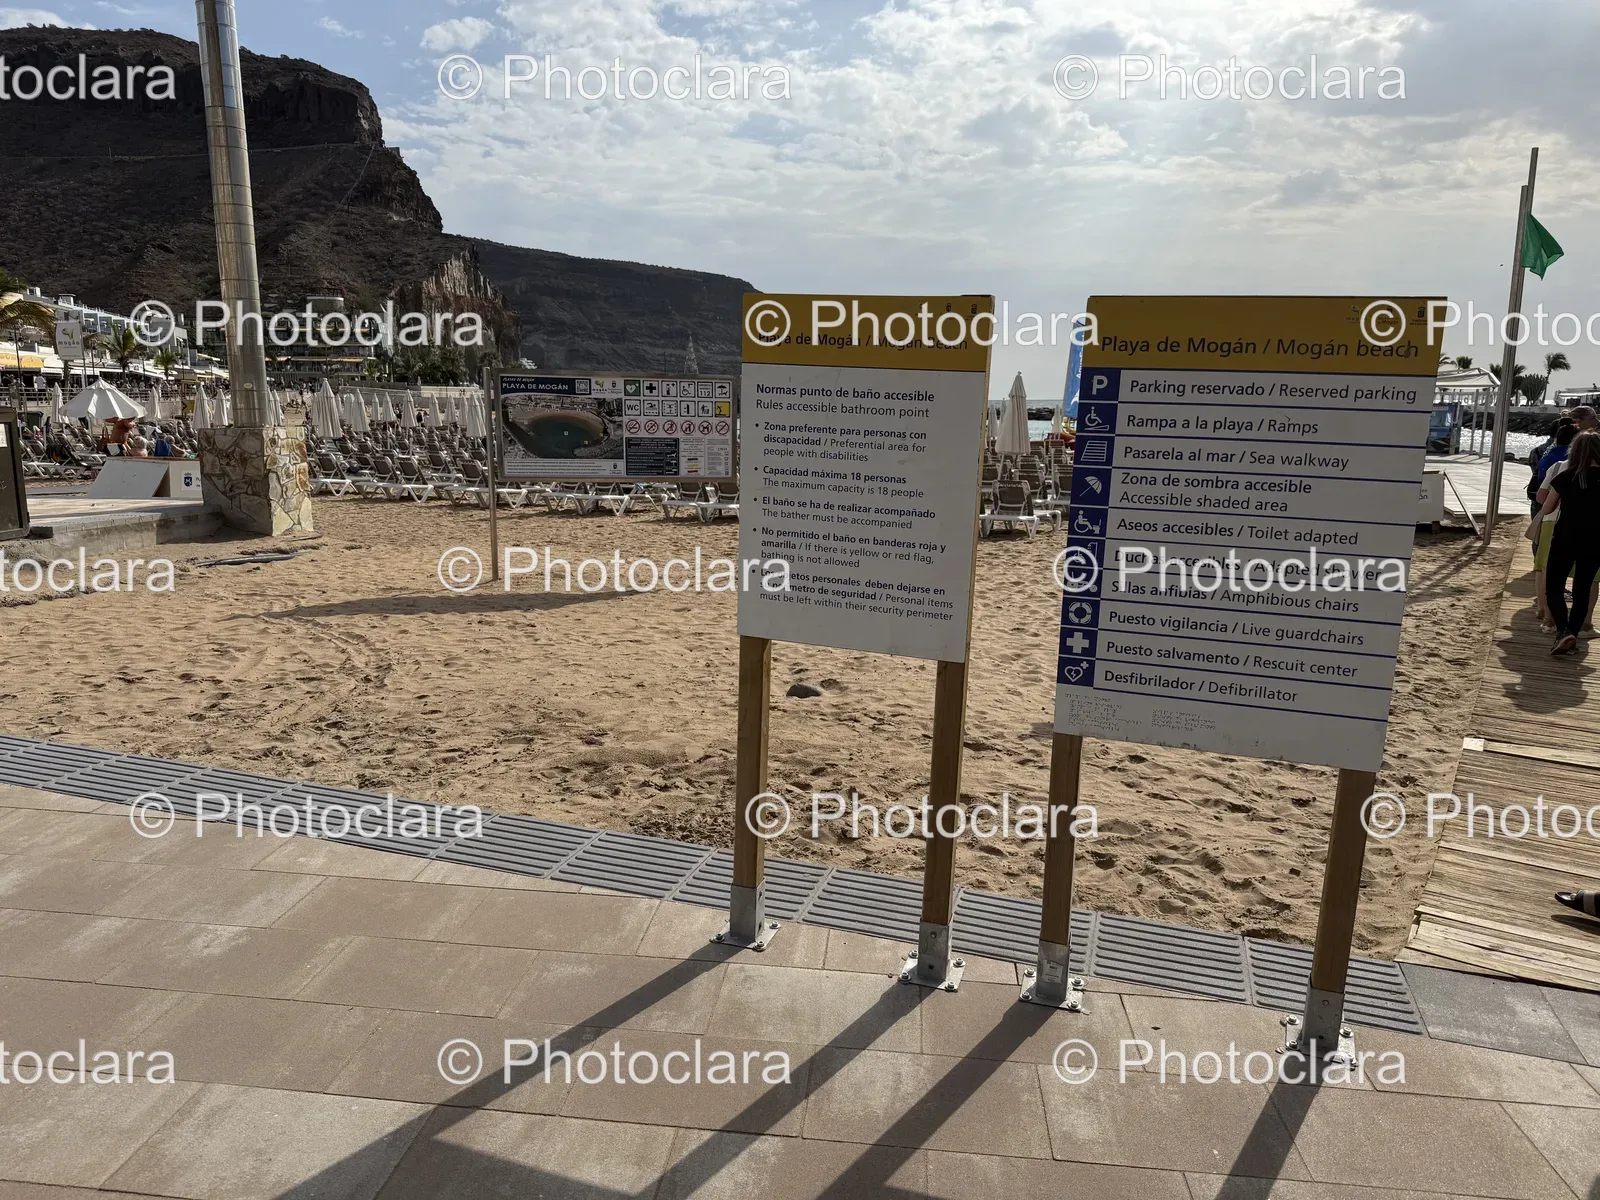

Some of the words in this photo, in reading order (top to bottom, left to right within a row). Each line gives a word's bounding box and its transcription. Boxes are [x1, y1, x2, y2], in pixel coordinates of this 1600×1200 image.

[796, 332, 811, 344] de
[1101, 336, 1150, 354] Playa
[1156, 336, 1181, 352] de
[1188, 337, 1257, 358] Mogán
[1276, 338, 1349, 359] Mogán
[1356, 340, 1418, 358] beach
[756, 383, 797, 396] Normas
[799, 387, 833, 398] punto
[835, 386, 850, 398] de
[852, 387, 881, 400] baño
[883, 390, 935, 402] accesible
[1129, 379, 1186, 398] Parking
[1190, 381, 1265, 396] reservado
[1278, 383, 1350, 399] Reserved
[1353, 385, 1417, 405] parking
[755, 398, 784, 410] Rules
[785, 401, 838, 413] accessible
[840, 402, 896, 416] bathroom
[898, 406, 930, 419] point
[763, 421, 787, 432] Zona
[788, 423, 838, 435] preferente
[839, 427, 861, 437] para
[863, 429, 907, 439] personas
[908, 431, 927, 440] con
[1126, 414, 1177, 432] Rampa
[1181, 418, 1190, 429] a
[1194, 415, 1208, 430] la
[1212, 416, 1254, 434] playa
[1267, 418, 1319, 437] Ramps
[763, 433, 822, 446] discapacidad
[830, 437, 885, 450] Preferential
[887, 443, 909, 452] area
[911, 442, 927, 453] for
[763, 446, 794, 458] people
[796, 448, 818, 458] with
[819, 449, 869, 462] disabilities
[1123, 445, 1184, 461] Pasarela
[1187, 447, 1202, 462] al
[1205, 451, 1237, 463] mar
[1248, 450, 1275, 465] Sea
[1280, 452, 1350, 472] walkway
[762, 465, 809, 477] Capacidad
[810, 469, 848, 480] máxima
[850, 471, 862, 481] 18
[863, 474, 907, 485] personas
[1120, 471, 1157, 486] Zona
[1161, 472, 1180, 487] de
[1183, 475, 1240, 490] sombra
[1243, 478, 1312, 494] accesible
[762, 476, 779, 487] The
[781, 479, 826, 491] maximum
[827, 483, 865, 496] capacity
[867, 485, 875, 495] is
[877, 486, 889, 496] 18
[890, 488, 924, 499] people
[762, 495, 770, 505] El
[772, 496, 796, 507] baño
[797, 500, 808, 508] se
[809, 499, 821, 510] ha
[822, 500, 835, 511] de
[837, 502, 872, 514] realizar
[873, 506, 936, 519] acompañado
[1118, 490, 1192, 507] Accessible
[1195, 494, 1250, 510] shaded
[1254, 500, 1288, 512] area
[761, 507, 778, 518] The
[780, 508, 810, 520] bather
[812, 514, 834, 523] must
[836, 514, 849, 524] be
[850, 517, 913, 530] accompanied
[761, 526, 774, 536] No
[776, 529, 820, 540] permitido
[821, 532, 831, 541] el
[832, 532, 856, 544] baño
[858, 537, 870, 545] en
[872, 536, 917, 549] banderas
[918, 541, 938, 553] roja
[939, 544, 947, 554] y
[1116, 517, 1158, 532] Aseos
[1161, 521, 1234, 537] accesibles
[1246, 525, 1290, 541] Toilet
[1293, 528, 1359, 547] adapted
[760, 539, 797, 550] amarilla
[804, 542, 812, 551] If
[813, 543, 838, 554] there
[840, 545, 847, 555] is
[849, 547, 880, 558] yellow
[881, 551, 893, 559] or
[894, 551, 911, 561] red
[912, 552, 934, 565] flag,
[760, 549, 795, 564] bathing
[797, 553, 804, 563] is
[805, 556, 822, 565] not
[823, 556, 860, 568] allowed
[1253, 560, 1320, 577] Adapted
[811, 575, 861, 587] personales
[864, 578, 894, 591] deben
[896, 582, 931, 594] dejarse
[932, 588, 946, 596] en
[817, 585, 829, 596] de
[830, 589, 877, 600] seguridad
[885, 592, 925, 606] Personal
[927, 597, 954, 609] items
[1111, 580, 1146, 595] Sllas
[1219, 589, 1311, 609] Amphibious
[1314, 596, 1359, 613] chairs
[759, 592, 781, 602] must
[782, 593, 794, 603] be
[796, 594, 812, 605] left
[813, 597, 843, 609] within
[844, 600, 867, 611] their
[868, 605, 904, 618] security
[906, 608, 953, 621] perimeter
[1108, 610, 1156, 627] Puesto
[1159, 615, 1228, 633] vigilancia
[1241, 622, 1271, 637] Live
[1274, 628, 1364, 646] guardchairs
[1106, 640, 1153, 657] Puesto
[1156, 646, 1240, 666] salvamento
[1252, 655, 1306, 673] Rescuit
[1309, 663, 1358, 678] center
[1104, 669, 1196, 691] Desfibrilador
[1207, 680, 1299, 702] Defibrillator
